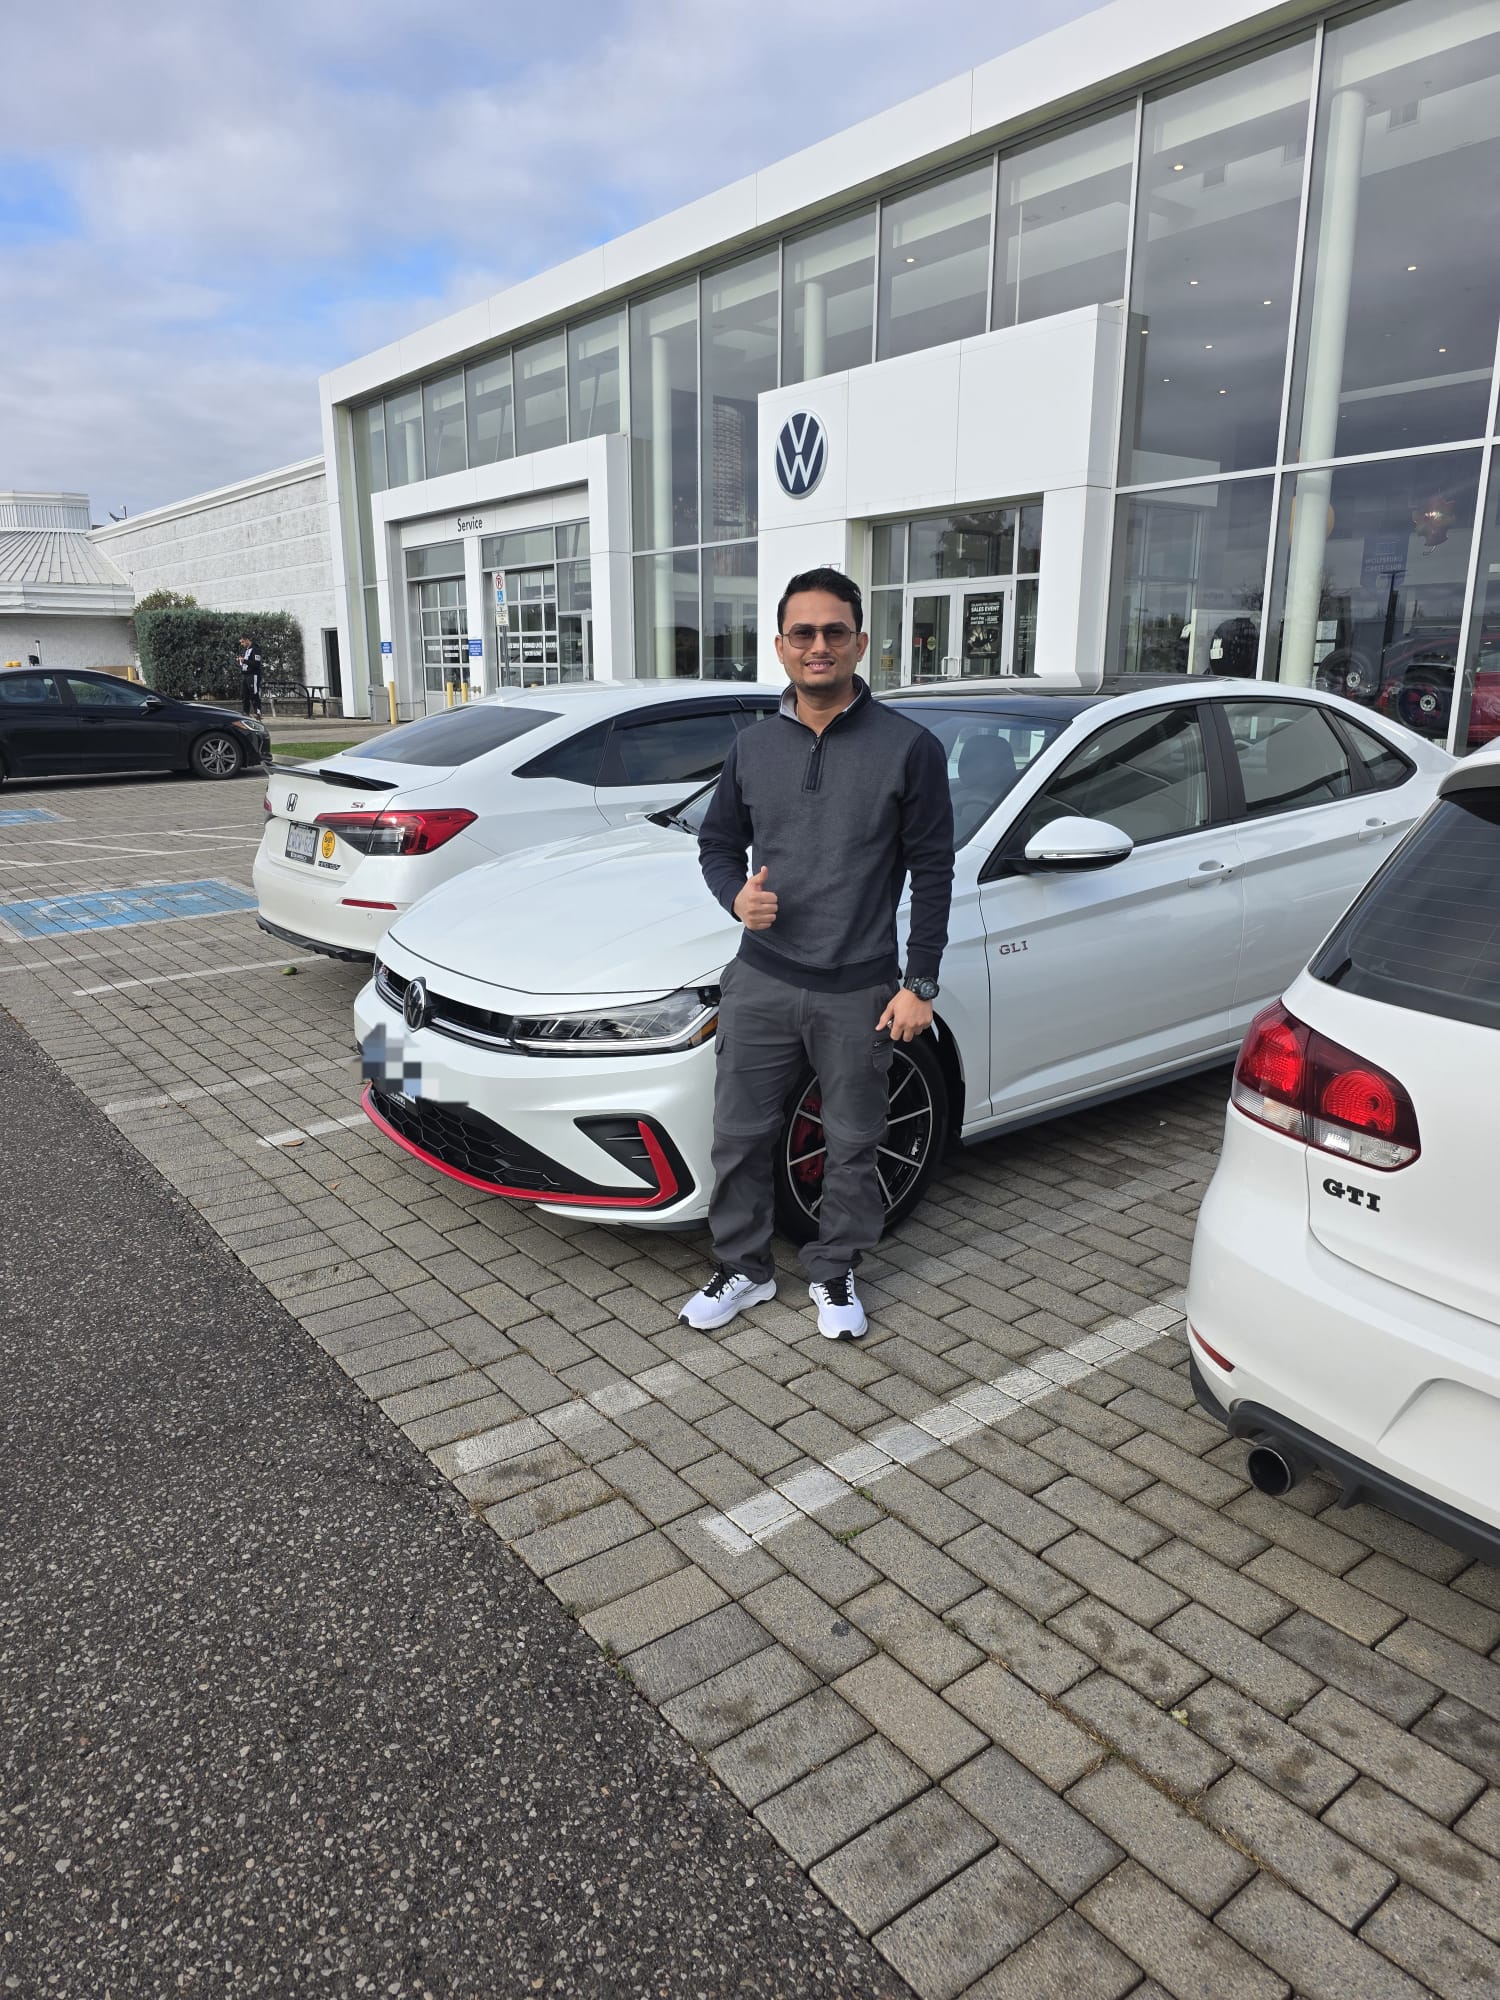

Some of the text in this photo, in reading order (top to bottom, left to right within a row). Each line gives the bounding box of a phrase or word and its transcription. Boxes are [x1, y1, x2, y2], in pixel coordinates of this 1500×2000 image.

[457, 516, 483, 532] Service
[1000, 940, 1028, 955] GLI
[1323, 1178, 1381, 1213] GTI
